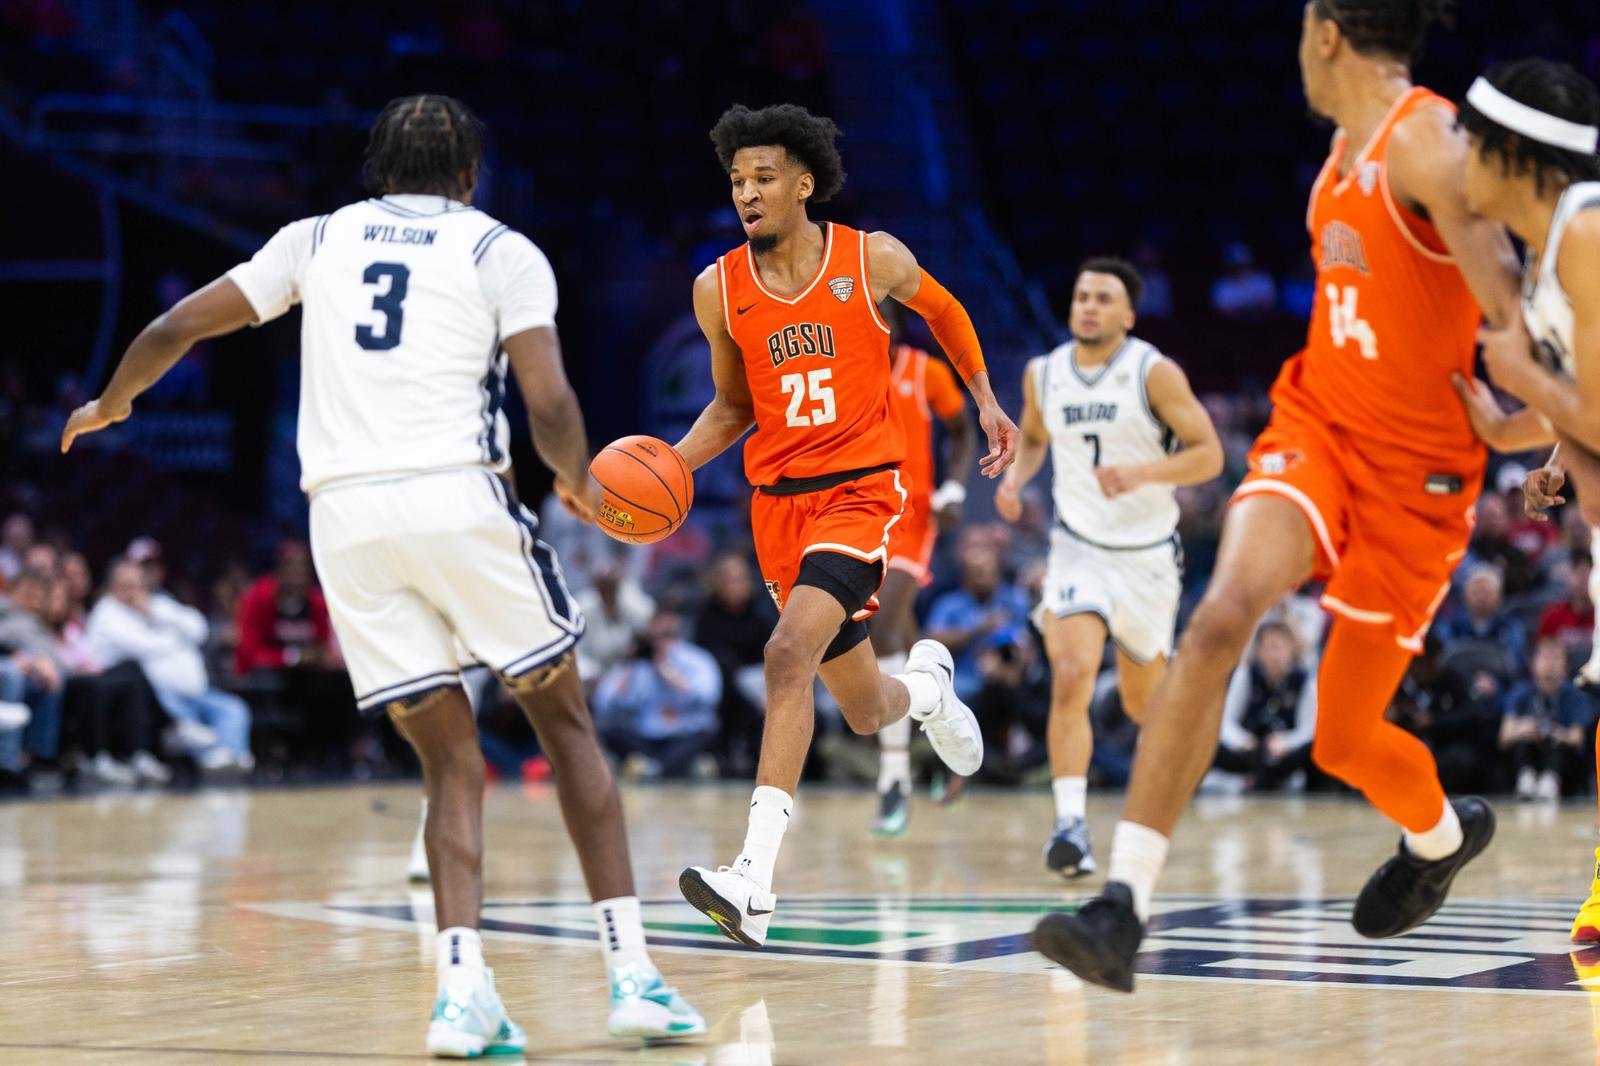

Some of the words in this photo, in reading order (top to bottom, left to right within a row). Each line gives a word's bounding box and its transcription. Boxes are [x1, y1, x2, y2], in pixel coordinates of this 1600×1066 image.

[363, 224, 438, 245] WILSON
[355, 262, 411, 351] 3
[1325, 283, 1379, 360] 14
[767, 321, 836, 369] BGSU
[781, 367, 837, 428] 25
[1083, 433, 1100, 468] 7
